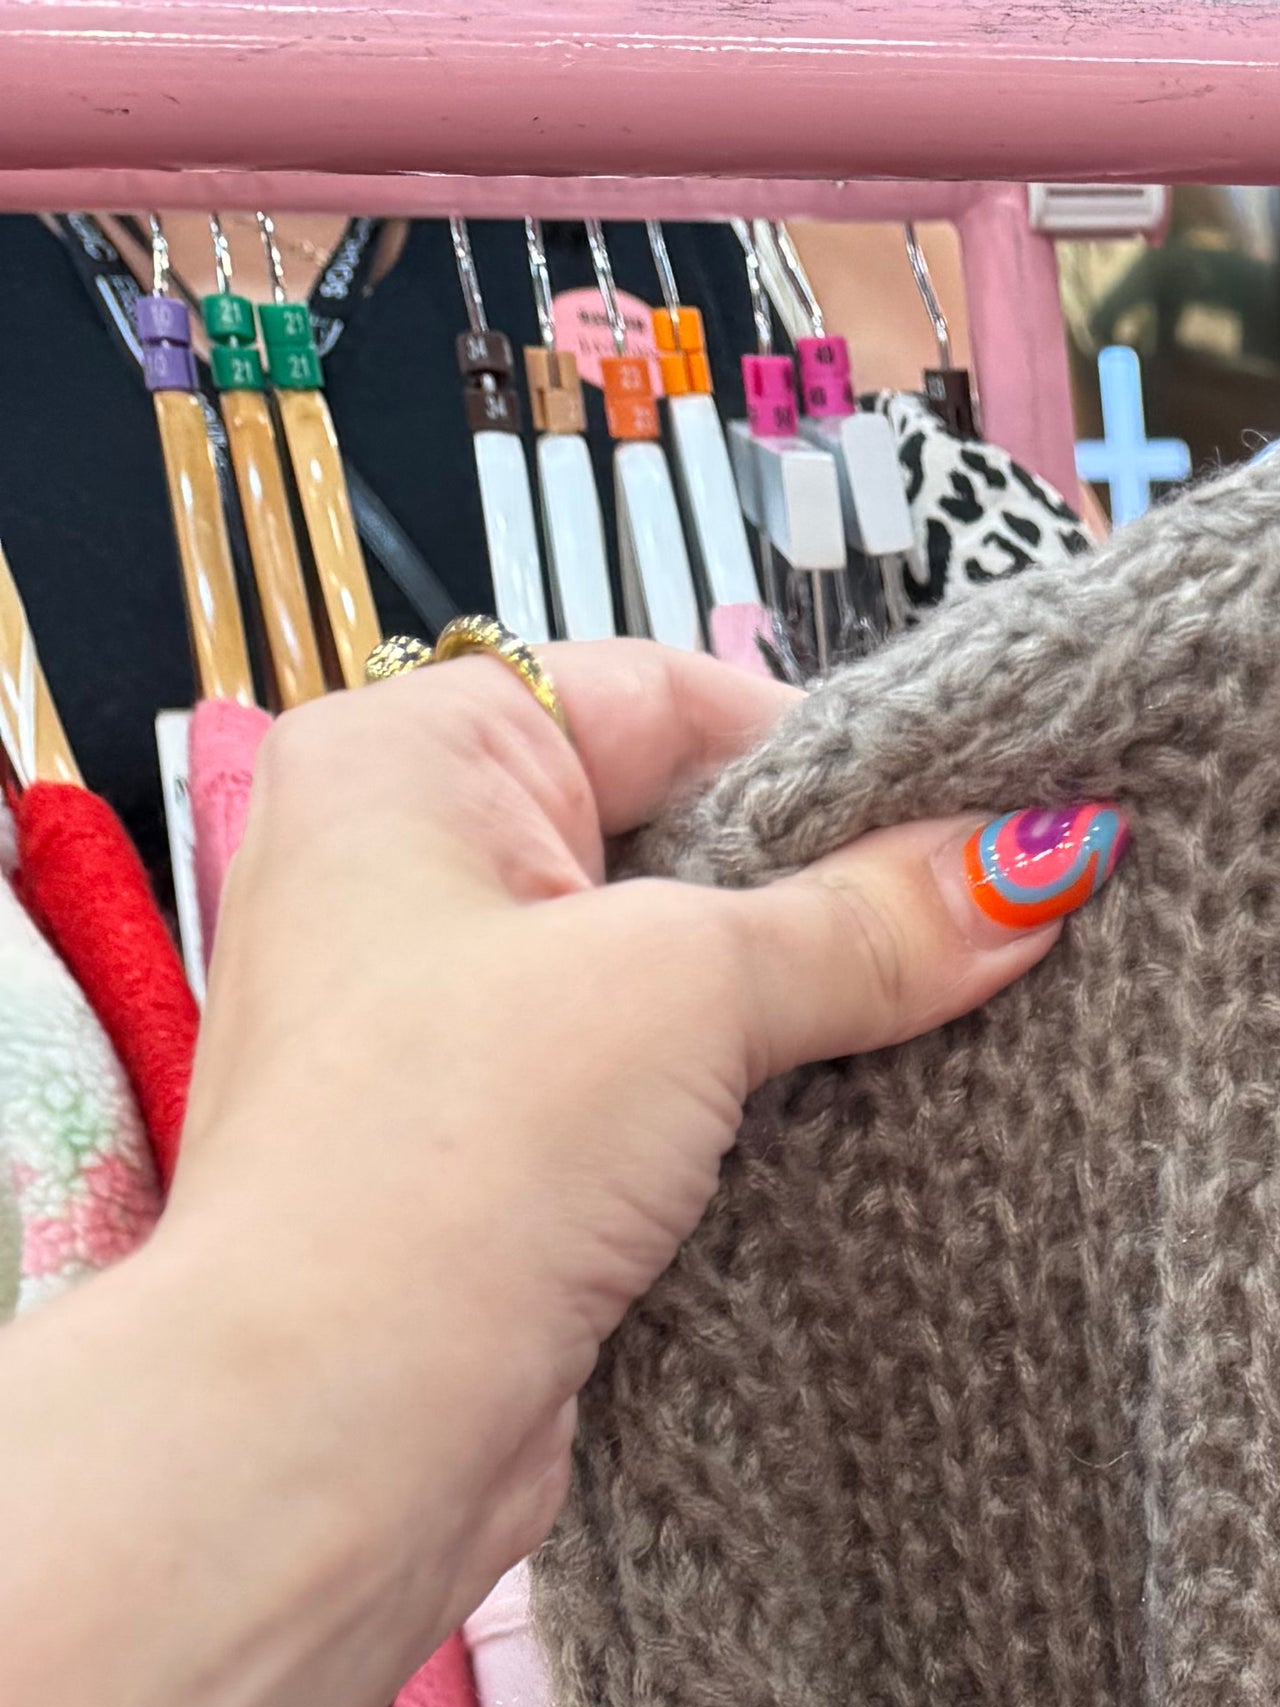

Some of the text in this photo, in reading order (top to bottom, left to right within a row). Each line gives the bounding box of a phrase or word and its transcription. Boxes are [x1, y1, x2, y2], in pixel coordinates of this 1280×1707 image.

[219, 297, 243, 327] 21
[282, 310, 306, 336] 21
[231, 357, 255, 384] 21
[289, 354, 313, 380] 21
